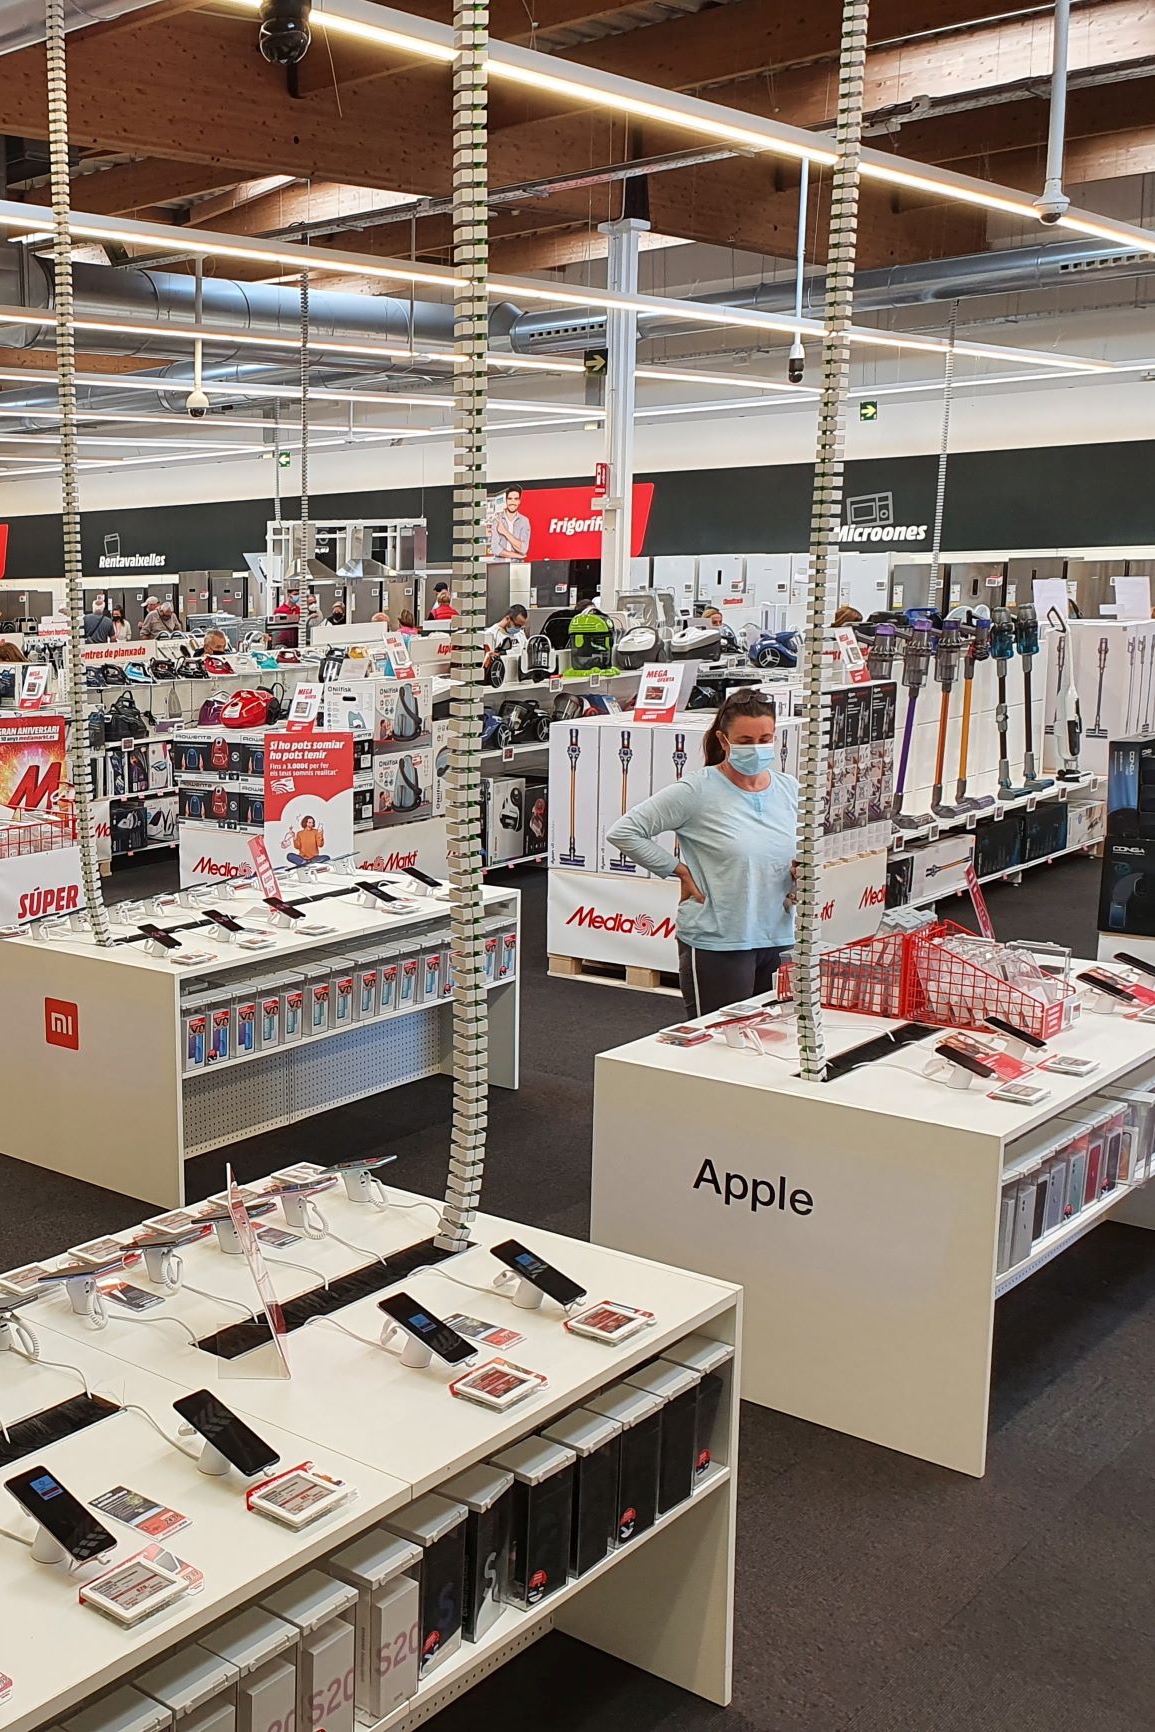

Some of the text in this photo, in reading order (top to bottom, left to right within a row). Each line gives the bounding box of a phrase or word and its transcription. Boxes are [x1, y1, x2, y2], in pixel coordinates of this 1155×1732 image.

[99, 553, 166, 569] Rentavaixelles
[646, 669, 668, 679] MEGA
[17, 726, 60, 735] ANIVERSARI
[269, 739, 345, 751] Si ho pots somiar
[269, 750, 327, 762] ho pots tenir
[1112, 845, 1145, 854] CONGA
[193, 857, 239, 878] Media
[17, 884, 79, 919] SÚPER
[565, 905, 636, 934] Media
[692, 1159, 814, 1216] Apple
